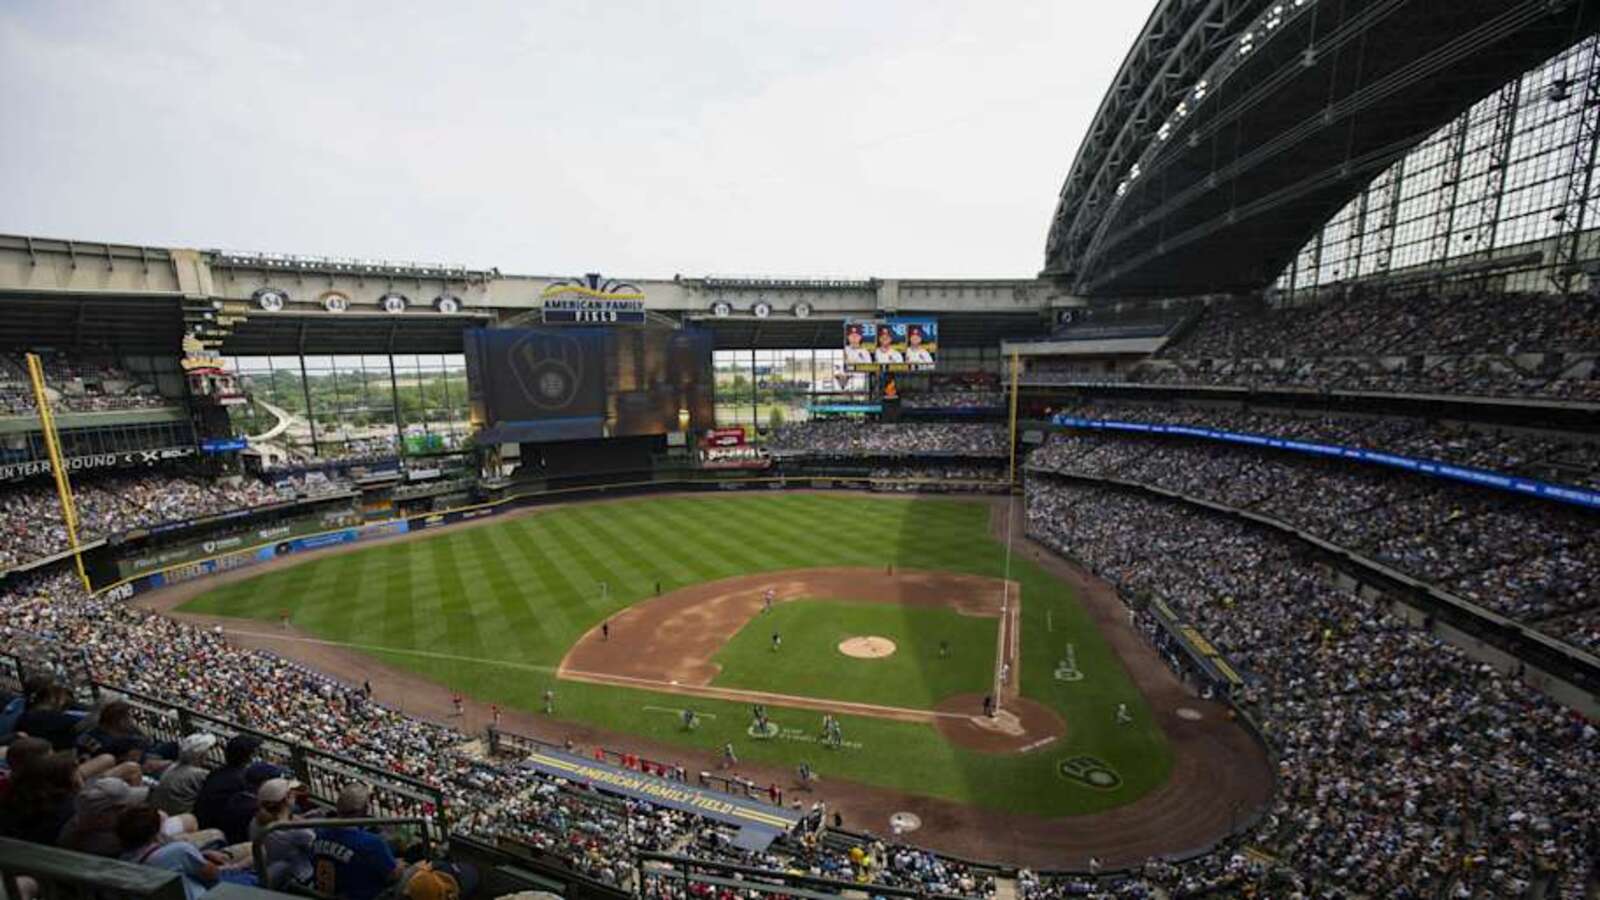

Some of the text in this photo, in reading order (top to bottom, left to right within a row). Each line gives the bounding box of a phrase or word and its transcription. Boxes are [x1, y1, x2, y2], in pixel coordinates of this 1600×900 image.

[544, 301, 643, 310] AMERICAN FAMILY
[575, 311, 617, 322] FIELD
[18, 460, 51, 475] YEAR
[575, 764, 733, 814] AMERICAN FAMILY FIELD
